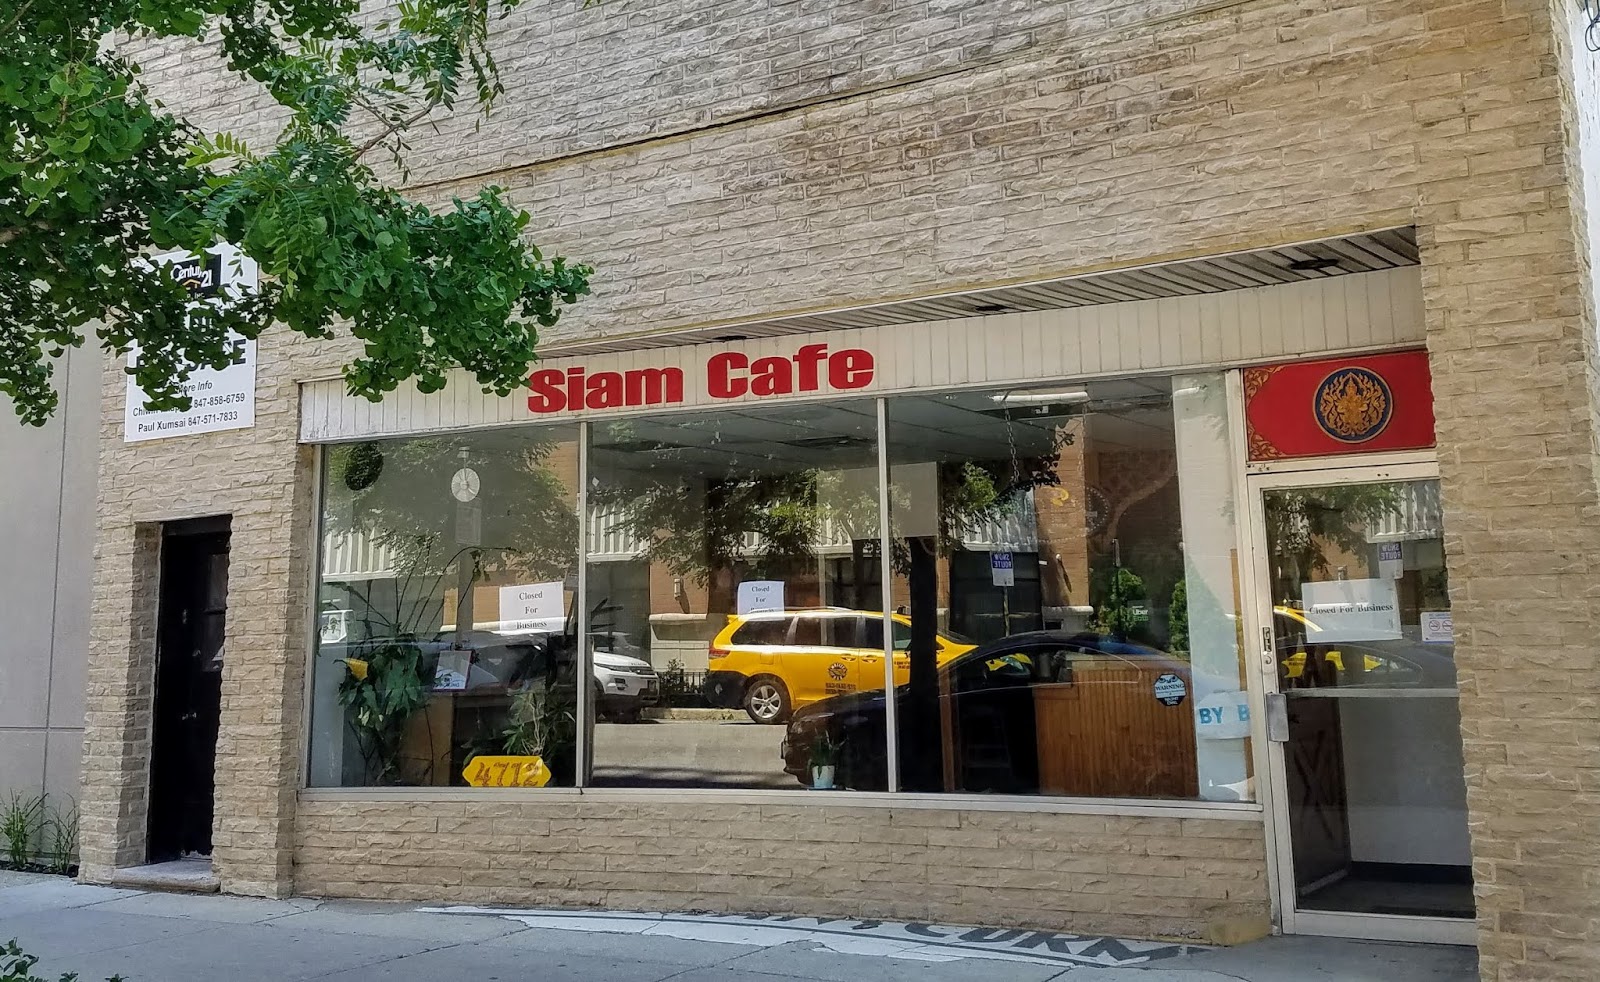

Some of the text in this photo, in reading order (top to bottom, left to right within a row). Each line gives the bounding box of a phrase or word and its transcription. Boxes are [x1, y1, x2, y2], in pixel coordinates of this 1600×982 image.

[201, 269, 213, 288] 21
[527, 343, 875, 414] Siam Cafe
[197, 380, 213, 392] Info
[193, 392, 246, 409] 847-858-6759
[138, 410, 238, 433] Paul Xumsai 847-571-7833
[519, 591, 543, 600] Closed
[525, 606, 538, 614] For
[1309, 606, 1336, 615] Closed
[1357, 603, 1394, 612] Business
[516, 621, 547, 630] Business
[1155, 683, 1185, 691] WARNING
[1199, 706, 1223, 724] BY
[473, 761, 539, 787] 4712
